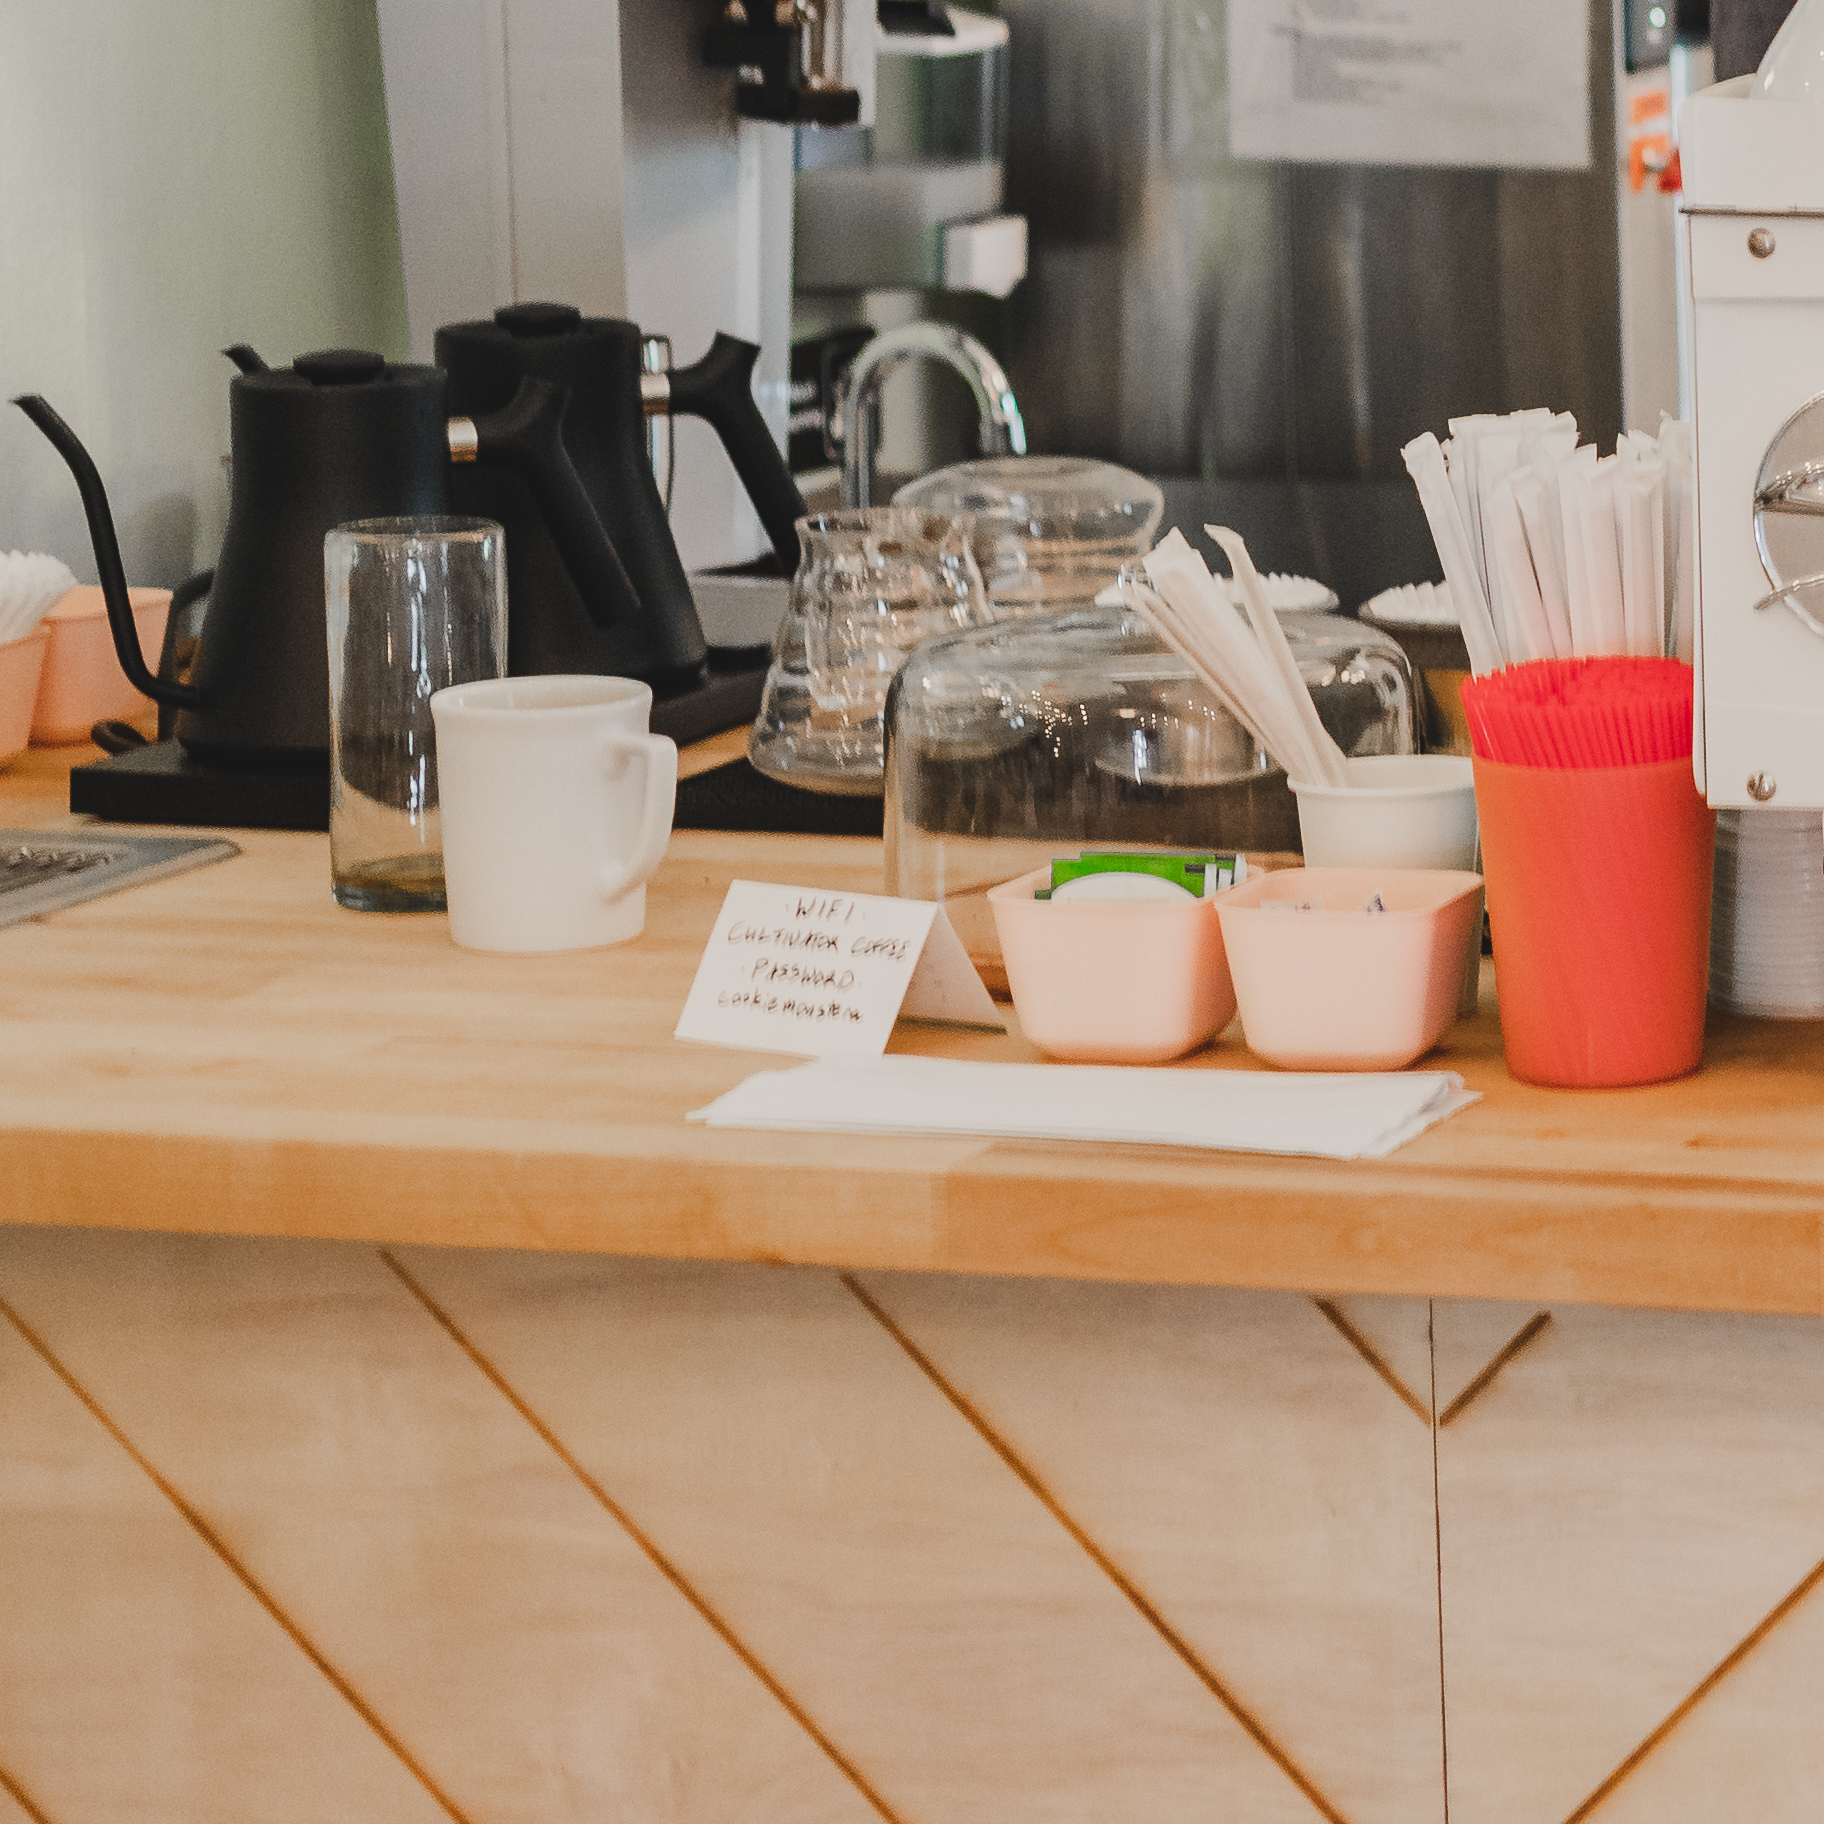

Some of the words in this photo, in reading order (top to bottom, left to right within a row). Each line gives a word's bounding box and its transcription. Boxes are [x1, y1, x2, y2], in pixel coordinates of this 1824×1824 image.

[795, 896, 856, 924] WIFI
[850, 934, 911, 963] COFFEE
[751, 957, 856, 992] PASSWORD
